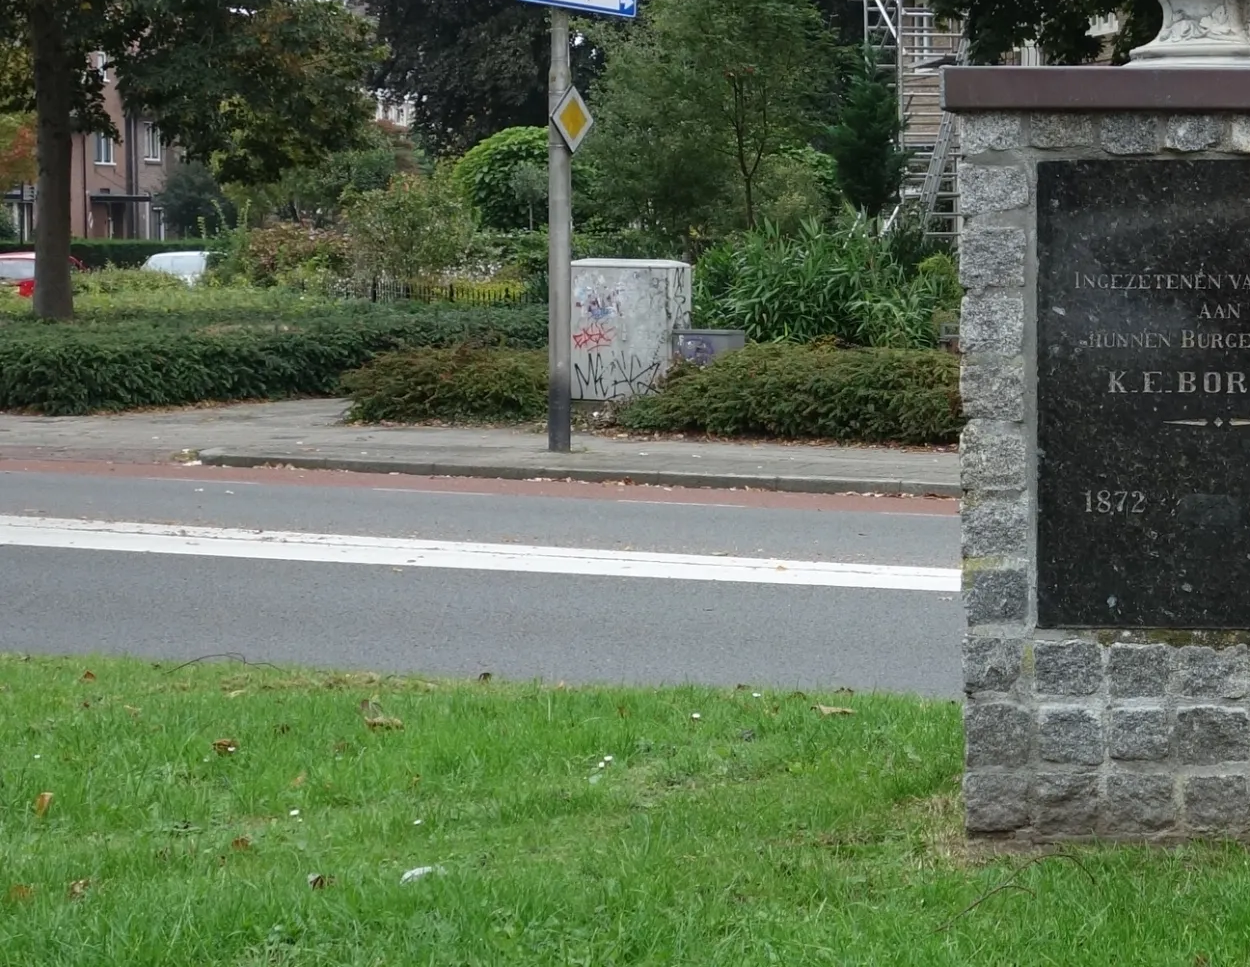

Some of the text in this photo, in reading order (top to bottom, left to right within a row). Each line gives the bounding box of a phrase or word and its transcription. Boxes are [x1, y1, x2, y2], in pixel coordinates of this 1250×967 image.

[1074, 271, 1221, 290] INGEZETENEN
[1199, 303, 1241, 319] AAN
[1089, 333, 1171, 348] HUNNEN
[1083, 490, 1146, 513] 1872
